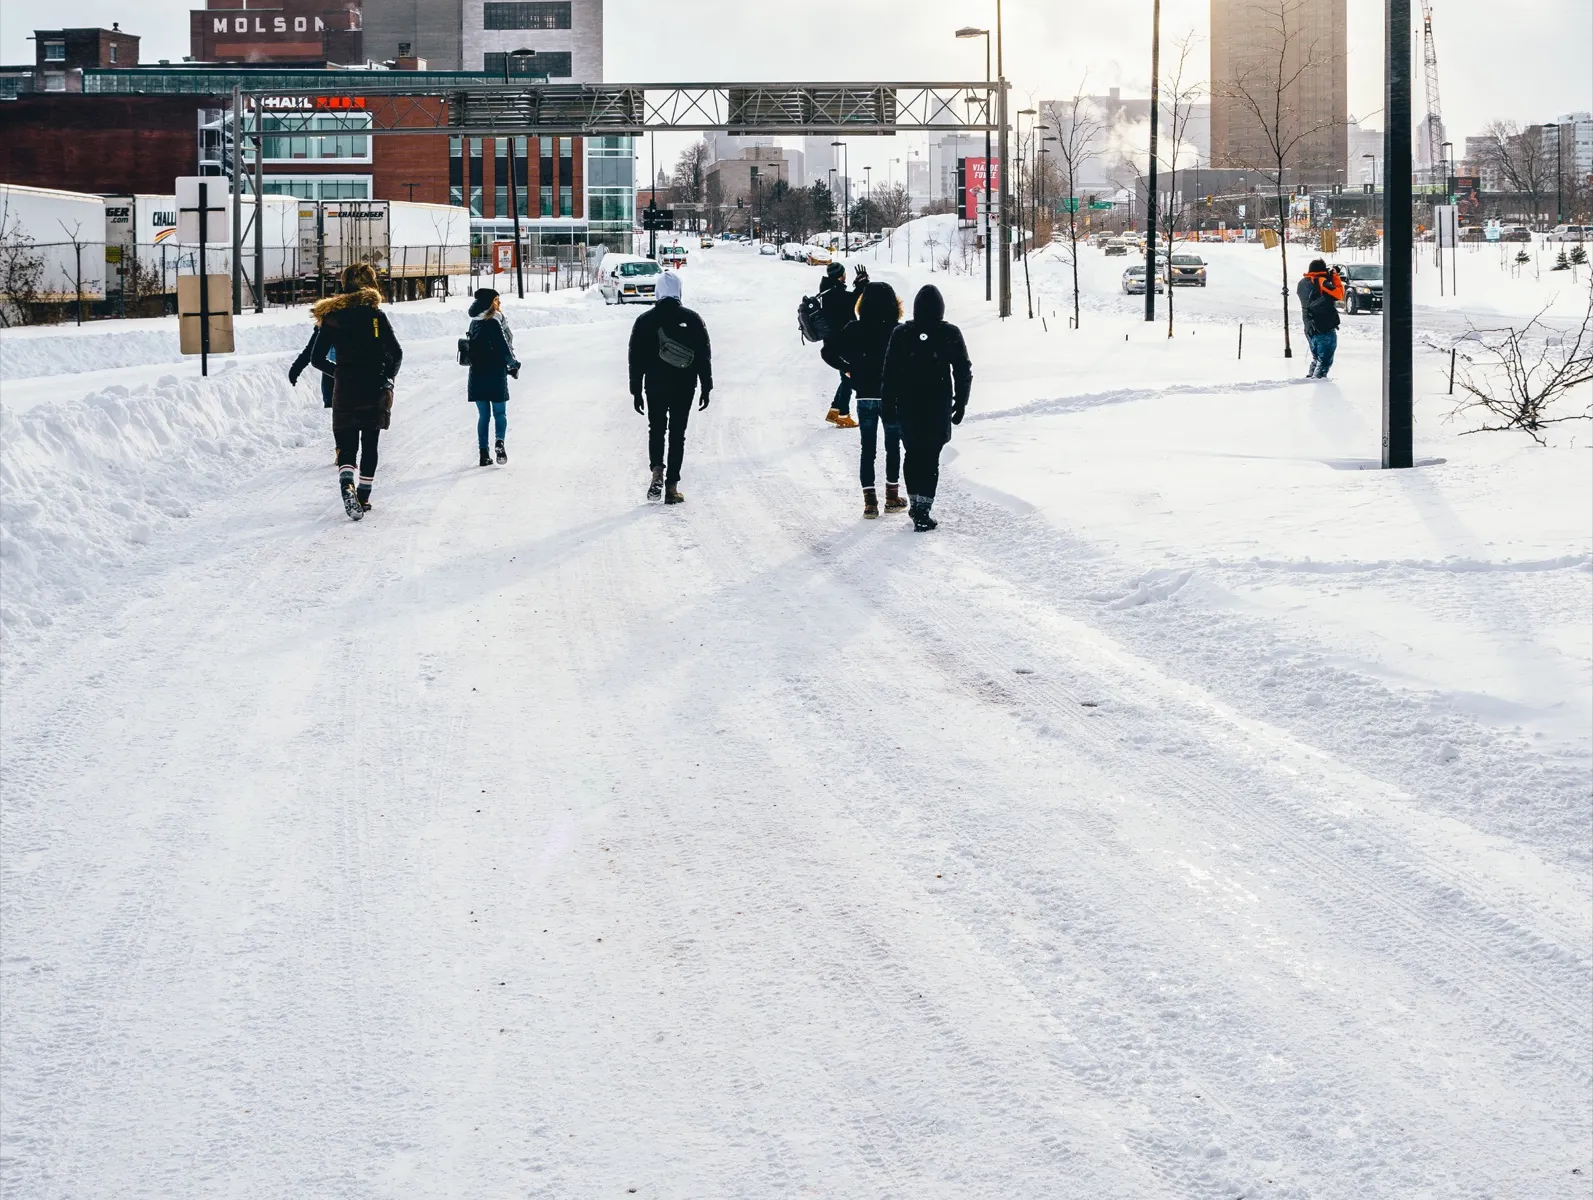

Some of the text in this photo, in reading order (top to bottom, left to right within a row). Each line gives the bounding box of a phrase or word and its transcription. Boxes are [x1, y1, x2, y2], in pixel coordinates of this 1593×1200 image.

[213, 16, 325, 33] MOLSON
[105, 207, 129, 217] GER
[152, 211, 177, 227] CHALL
